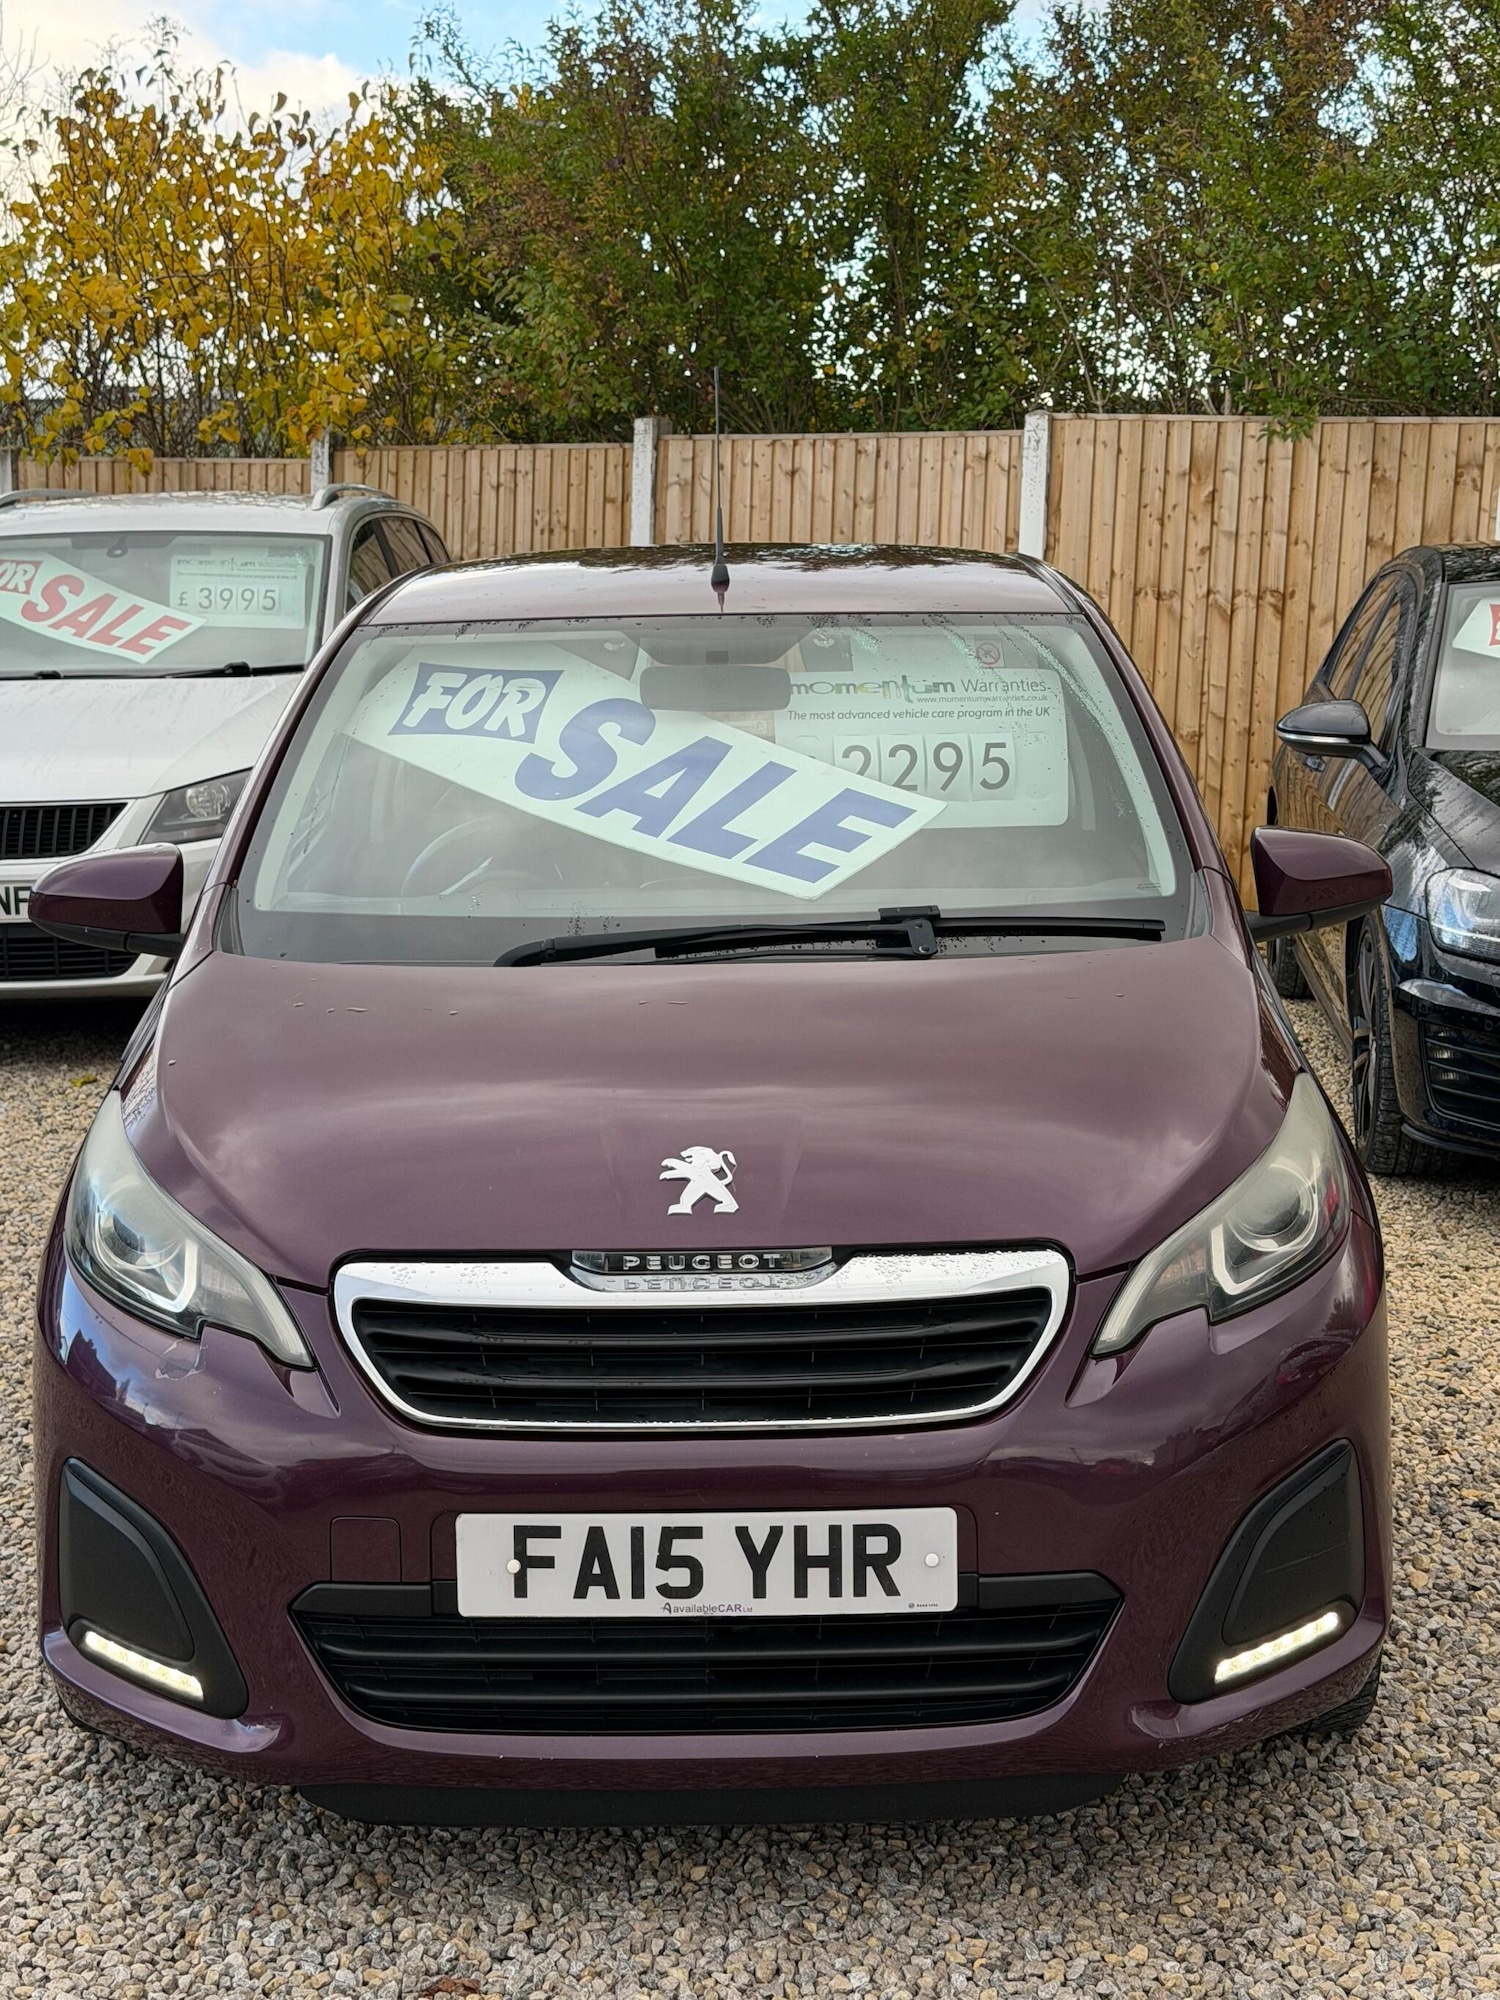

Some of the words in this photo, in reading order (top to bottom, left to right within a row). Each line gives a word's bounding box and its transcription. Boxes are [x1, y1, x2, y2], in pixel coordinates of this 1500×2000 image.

[21, 574, 192, 656] SALE
[178, 591, 188, 607] £
[198, 587, 277, 611] 3995
[789, 674, 955, 704] momentum
[960, 678, 1047, 693] Warranties
[788, 710, 807, 720] The
[809, 710, 835, 720] most
[837, 709, 890, 720] advanced
[892, 708, 929, 719] vehicle
[931, 709, 955, 718] care
[957, 709, 1003, 719] program
[1005, 707, 1014, 717] in
[1016, 707, 1033, 717] the
[1035, 706, 1051, 717] UK
[402, 671, 547, 738] FOR
[514, 697, 918, 885] SALE
[842, 741, 1010, 791] 2295
[622, 1253, 781, 1270] PEUGEOT
[512, 1524, 704, 1600] FA15
[734, 1523, 902, 1599] YHR
